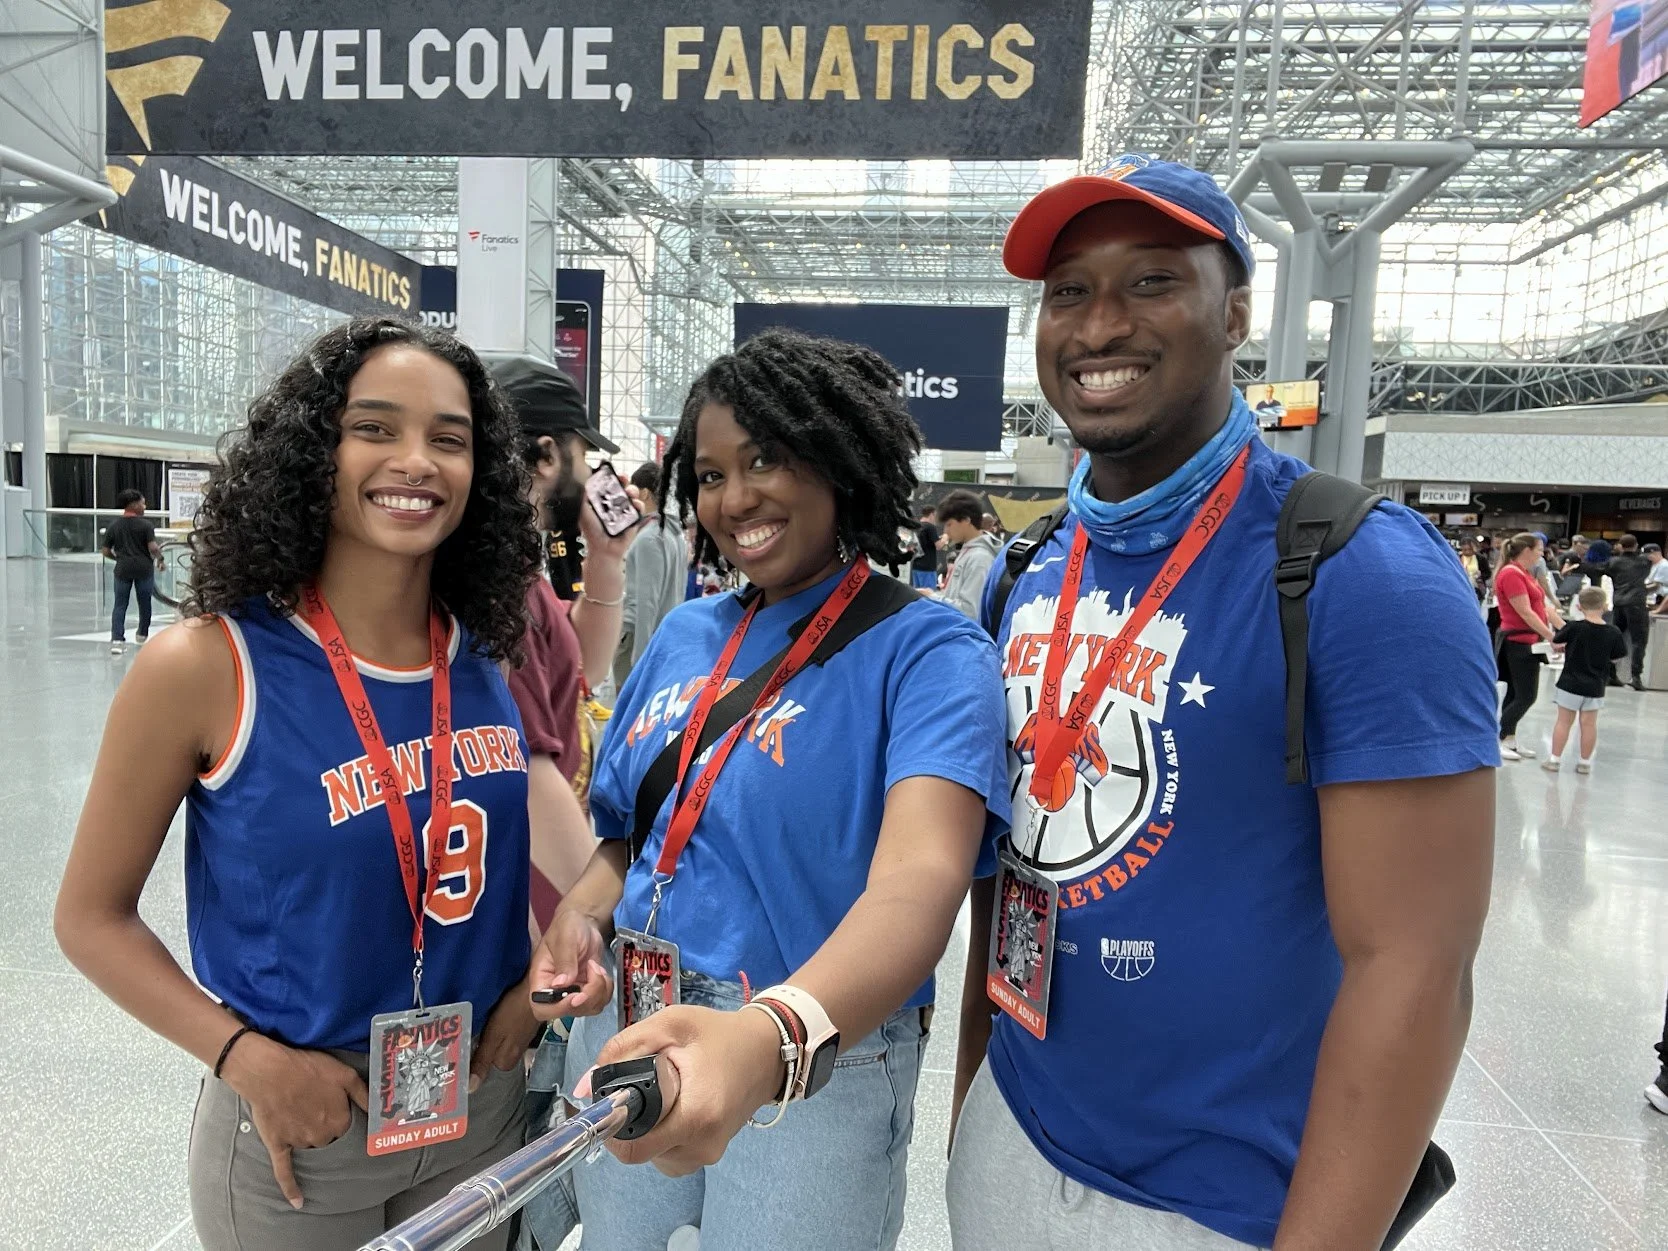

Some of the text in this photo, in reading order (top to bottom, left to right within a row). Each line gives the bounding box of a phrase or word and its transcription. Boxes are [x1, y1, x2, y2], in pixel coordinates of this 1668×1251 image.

[252, 23, 1036, 113] WELCOME, FANATICS
[160, 168, 411, 310] WELCOME, FANATICS
[481, 234, 519, 244] Fanatics
[898, 368, 959, 399] tics
[1422, 491, 1445, 501] PICK
[1447, 492, 1460, 501] UP
[550, 541, 567, 558] 96
[1066, 507, 1220, 731] CGC JSA CGC JSA
[327, 637, 348, 662] JSA
[1044, 675, 1057, 705] CGC
[1057, 610, 1071, 632] JSA
[695, 770, 715, 797] CGC
[815, 615, 833, 636] JSA
[847, 569, 866, 591] CGC
[1080, 634, 1168, 706] YRK
[353, 700, 373, 728] CGC
[684, 672, 722, 745] JSA CGC
[436, 719, 448, 736] JSA
[321, 738, 426, 827] NEW
[381, 768, 398, 794] JSA
[1160, 729, 1179, 815] NEW YORK
[436, 780, 448, 808] CGC
[399, 834, 413, 864] CGC
[422, 798, 488, 926] 9
[1109, 940, 1155, 957] PLAYOFFS
[991, 982, 1041, 1030] SUNDAY ADULT
[434, 1063, 449, 1075] NEW
[375, 1122, 459, 1149] SUNDAY ADULT
